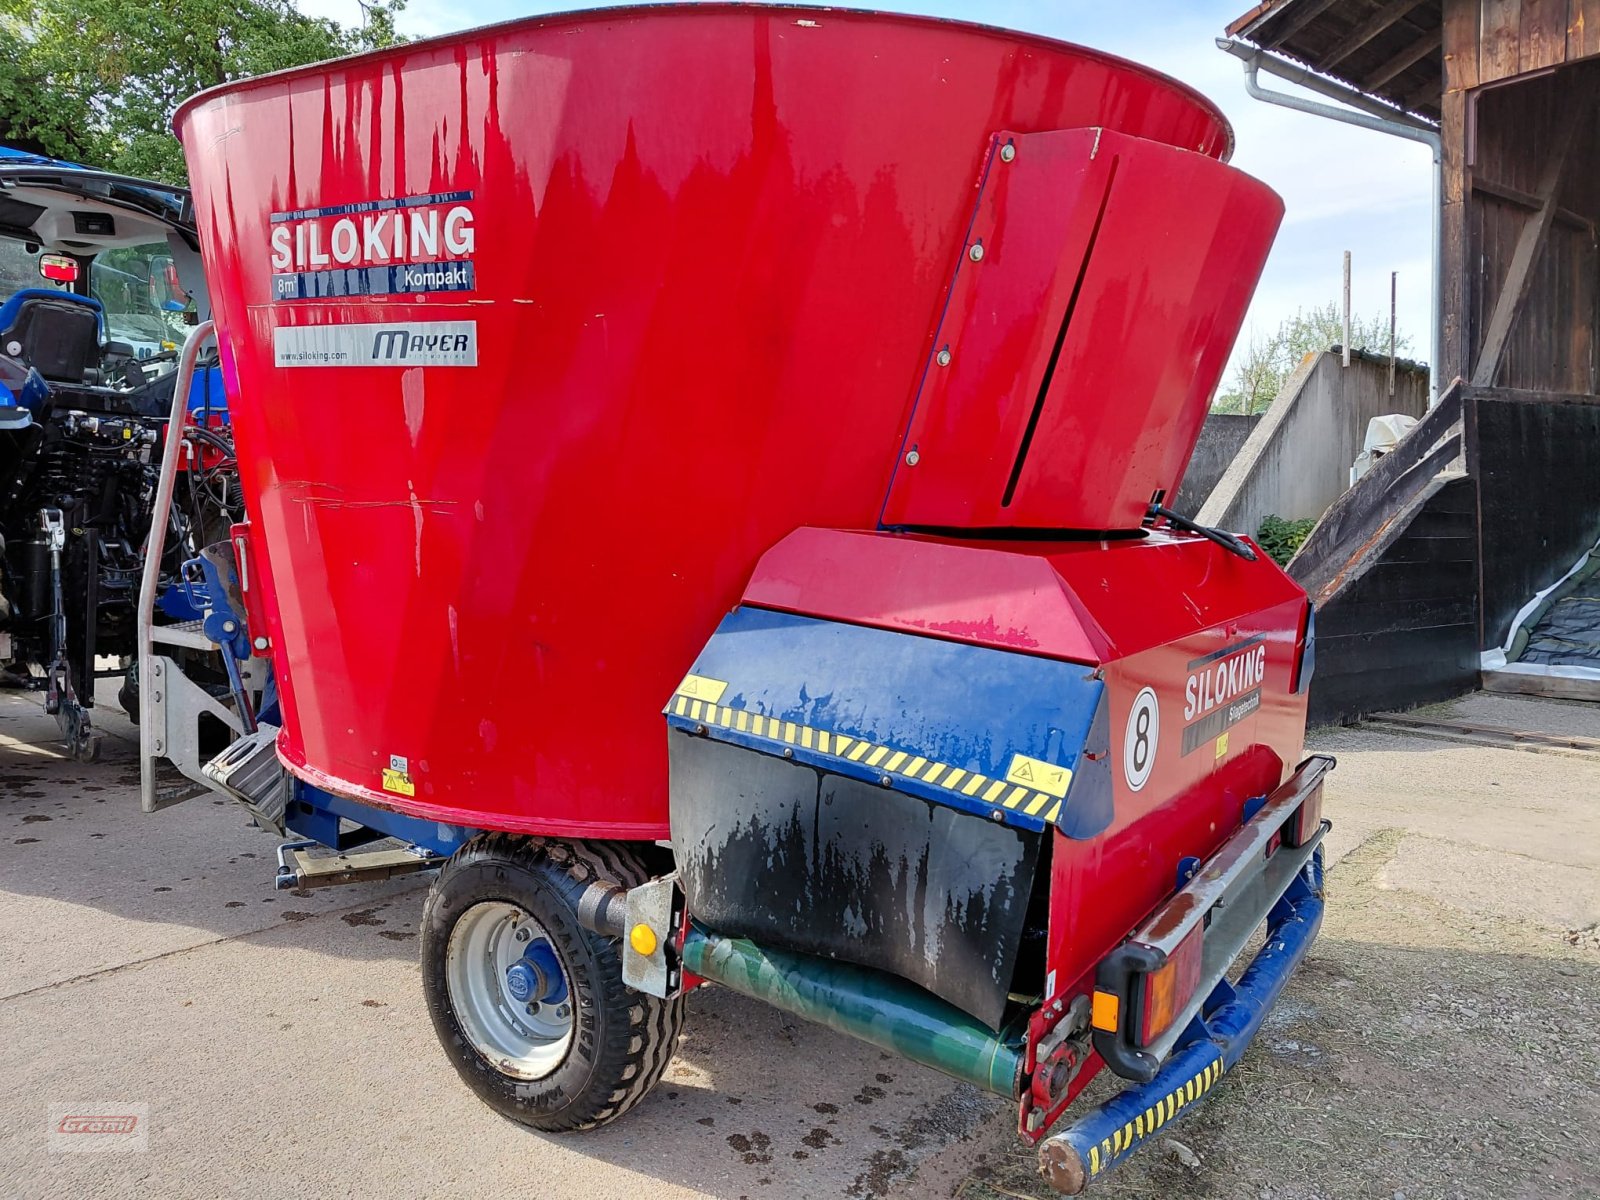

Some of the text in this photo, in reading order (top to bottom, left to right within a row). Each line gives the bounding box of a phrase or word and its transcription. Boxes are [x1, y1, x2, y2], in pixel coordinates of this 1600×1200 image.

[271, 206, 475, 270] SILOKING
[404, 268, 467, 289] Kompakt
[280, 351, 348, 362] www.siloking.com
[372, 330, 469, 359] MAYER
[1184, 644, 1266, 721] SILOKING
[1133, 706, 1150, 773] 8
